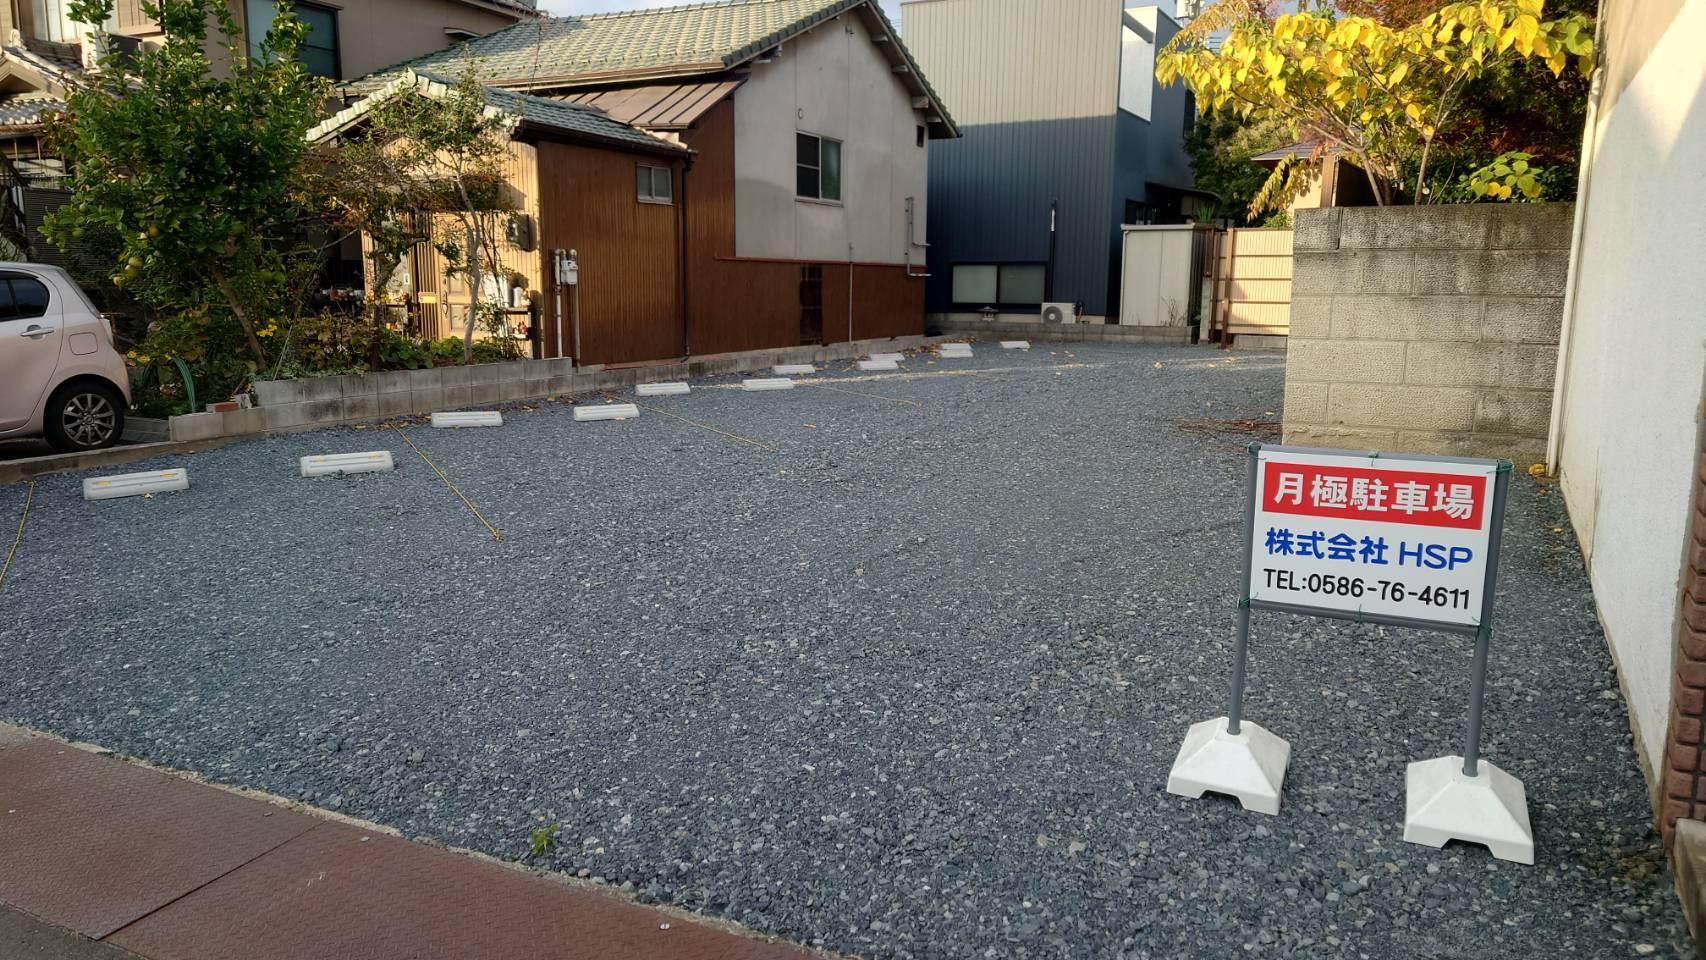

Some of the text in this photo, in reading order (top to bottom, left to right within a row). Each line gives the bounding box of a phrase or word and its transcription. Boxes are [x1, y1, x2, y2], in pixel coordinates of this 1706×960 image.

[1274, 472, 1475, 520] 月極駐車場
[1265, 527, 1473, 571] 株式会社 HSP
[1263, 568, 1471, 609] TEL:0586-76-4611
